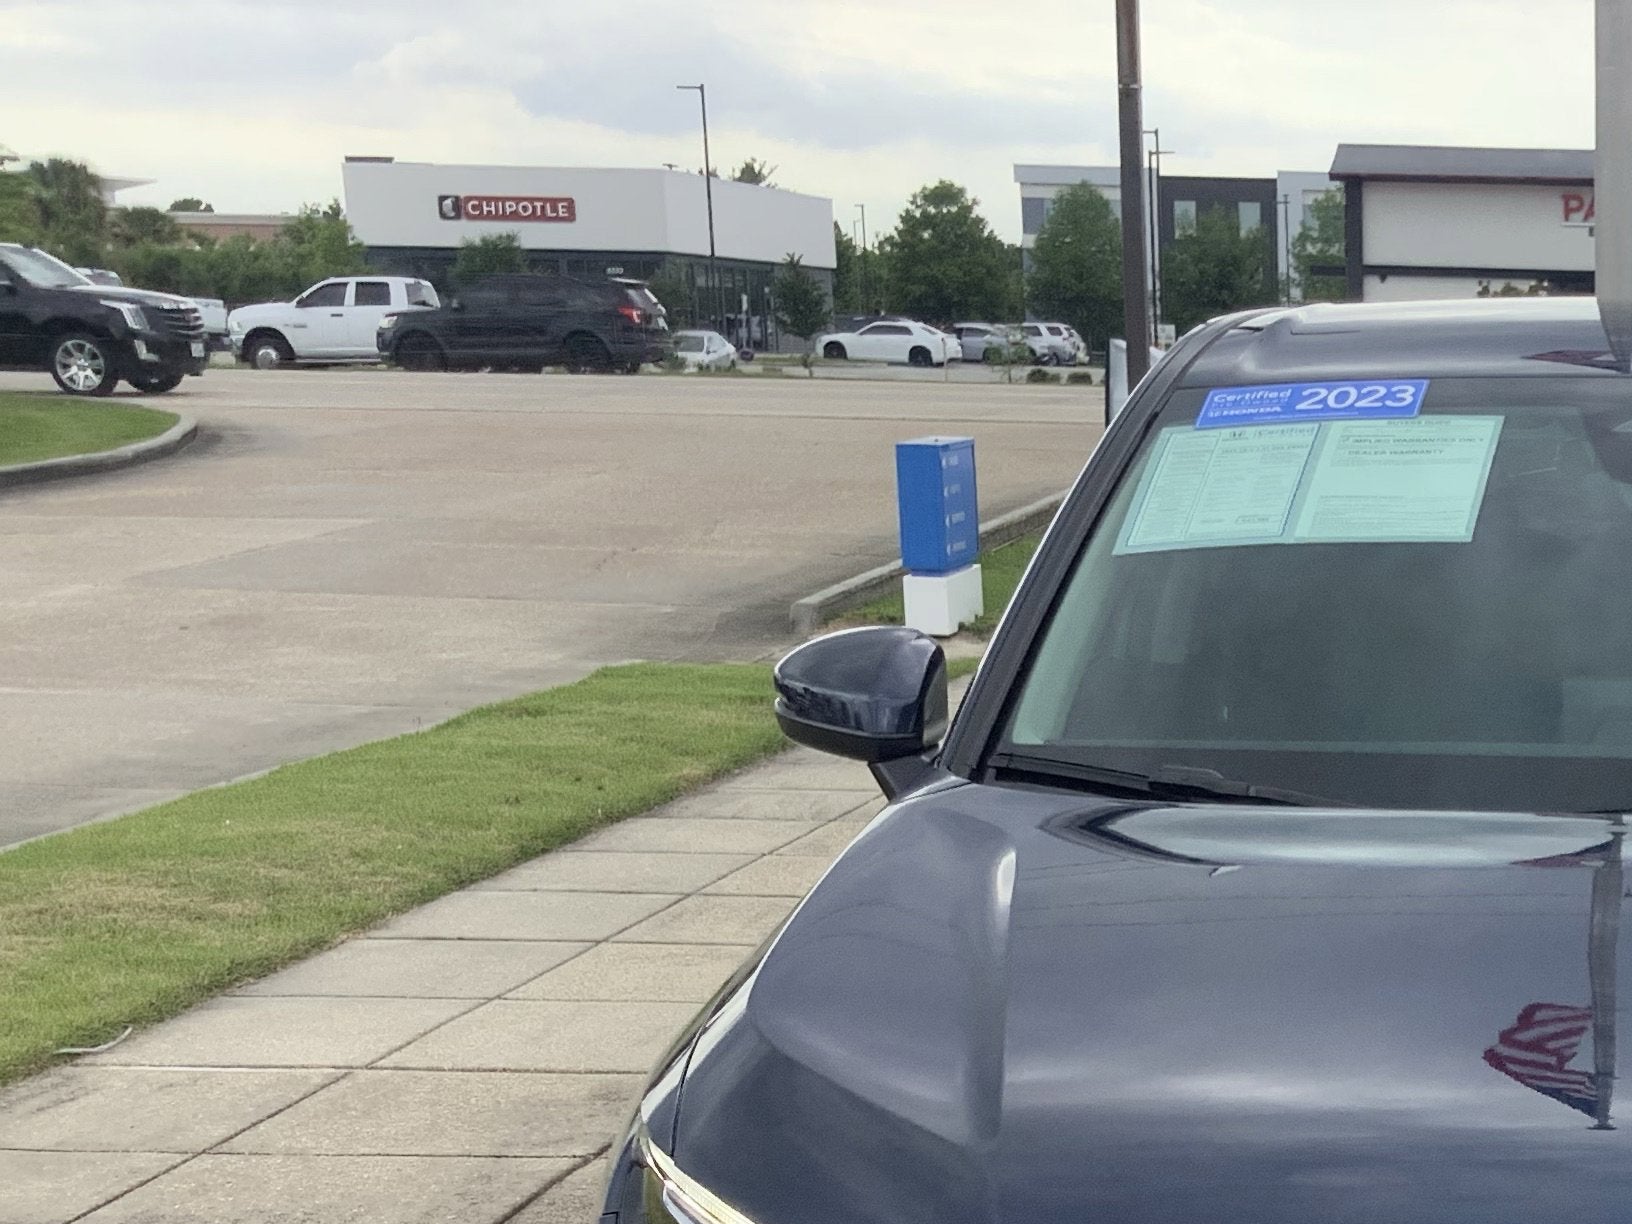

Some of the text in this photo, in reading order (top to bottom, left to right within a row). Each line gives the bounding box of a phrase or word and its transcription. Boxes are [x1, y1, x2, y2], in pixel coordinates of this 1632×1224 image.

[467, 200, 570, 217] CHIPOTLE
[1213, 385, 1417, 410] Certified 2023
